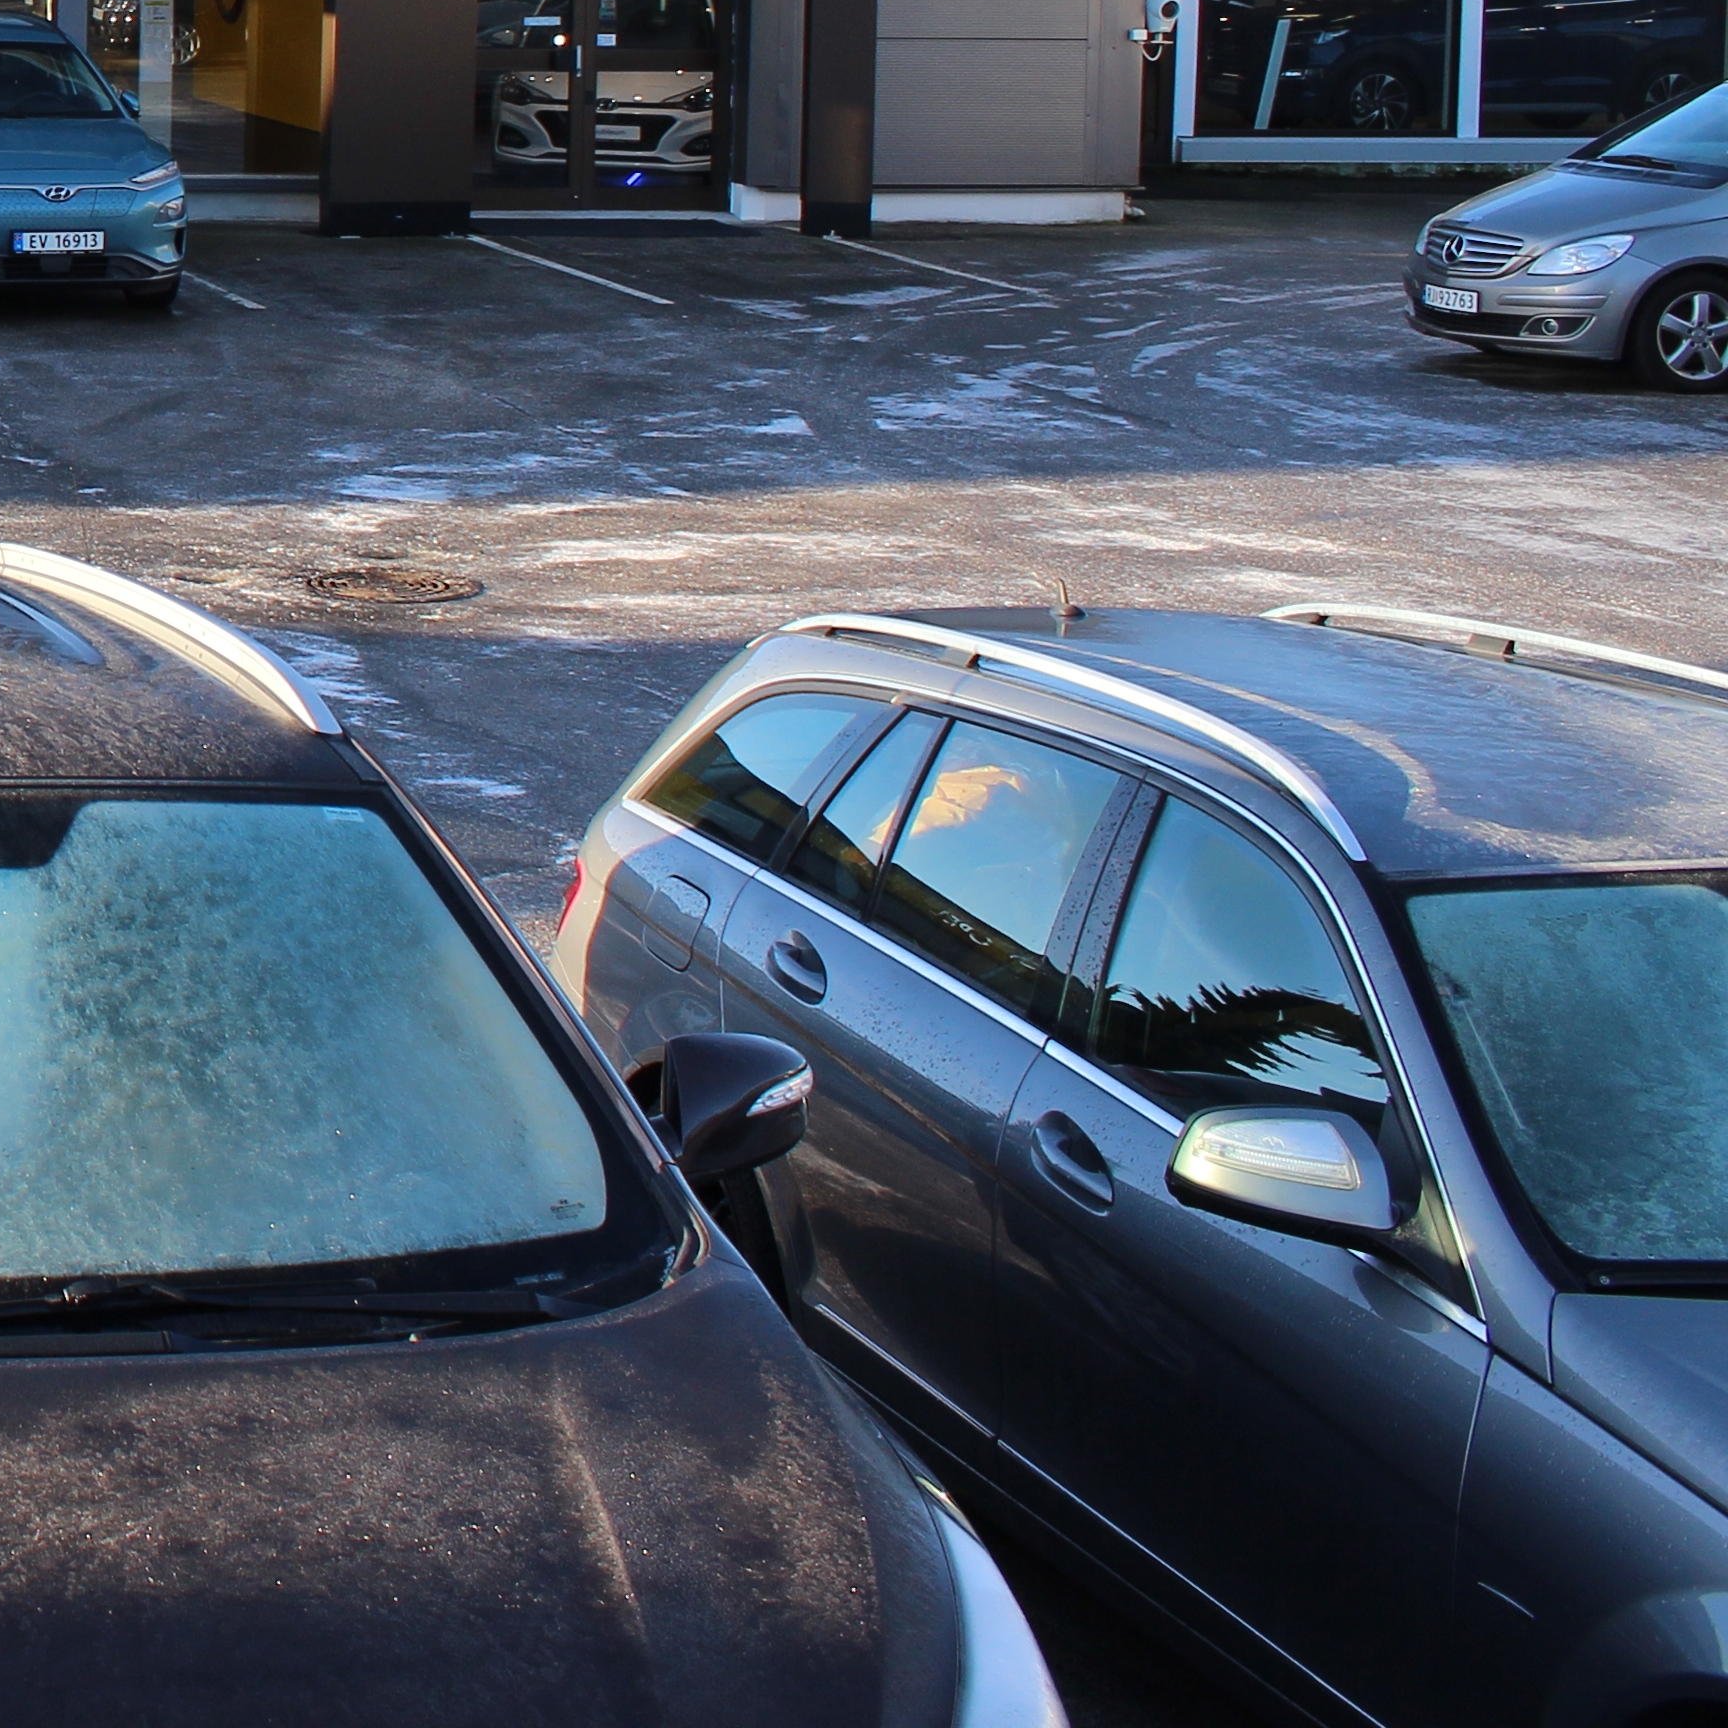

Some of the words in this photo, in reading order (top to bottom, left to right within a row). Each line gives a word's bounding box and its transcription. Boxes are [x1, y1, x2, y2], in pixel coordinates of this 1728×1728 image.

[29, 234, 48, 249] EV
[55, 233, 98, 249] 16913
[1438, 290, 1474, 310] 92763
